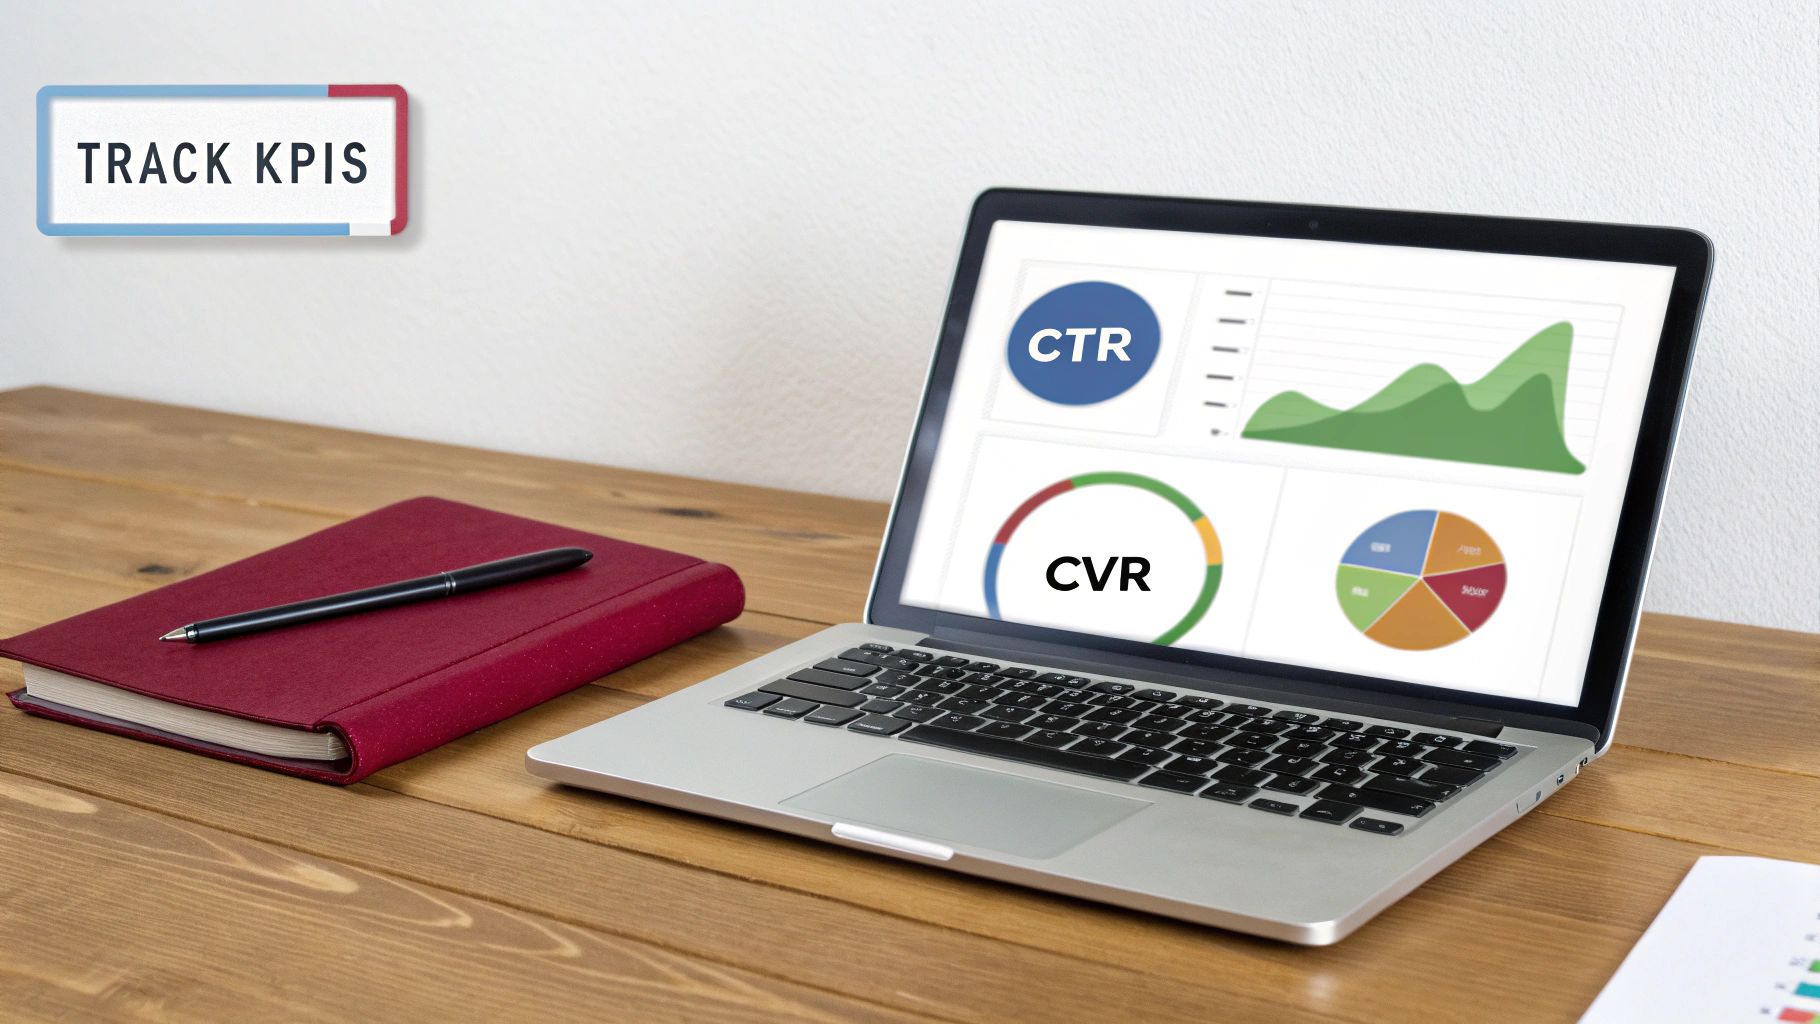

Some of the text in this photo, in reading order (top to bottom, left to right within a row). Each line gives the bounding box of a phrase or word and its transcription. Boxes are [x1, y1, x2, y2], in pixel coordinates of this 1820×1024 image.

[77, 141, 368, 185] TRACK KPIS
[1028, 327, 1132, 363] CTR
[1045, 555, 1152, 592] CVR
